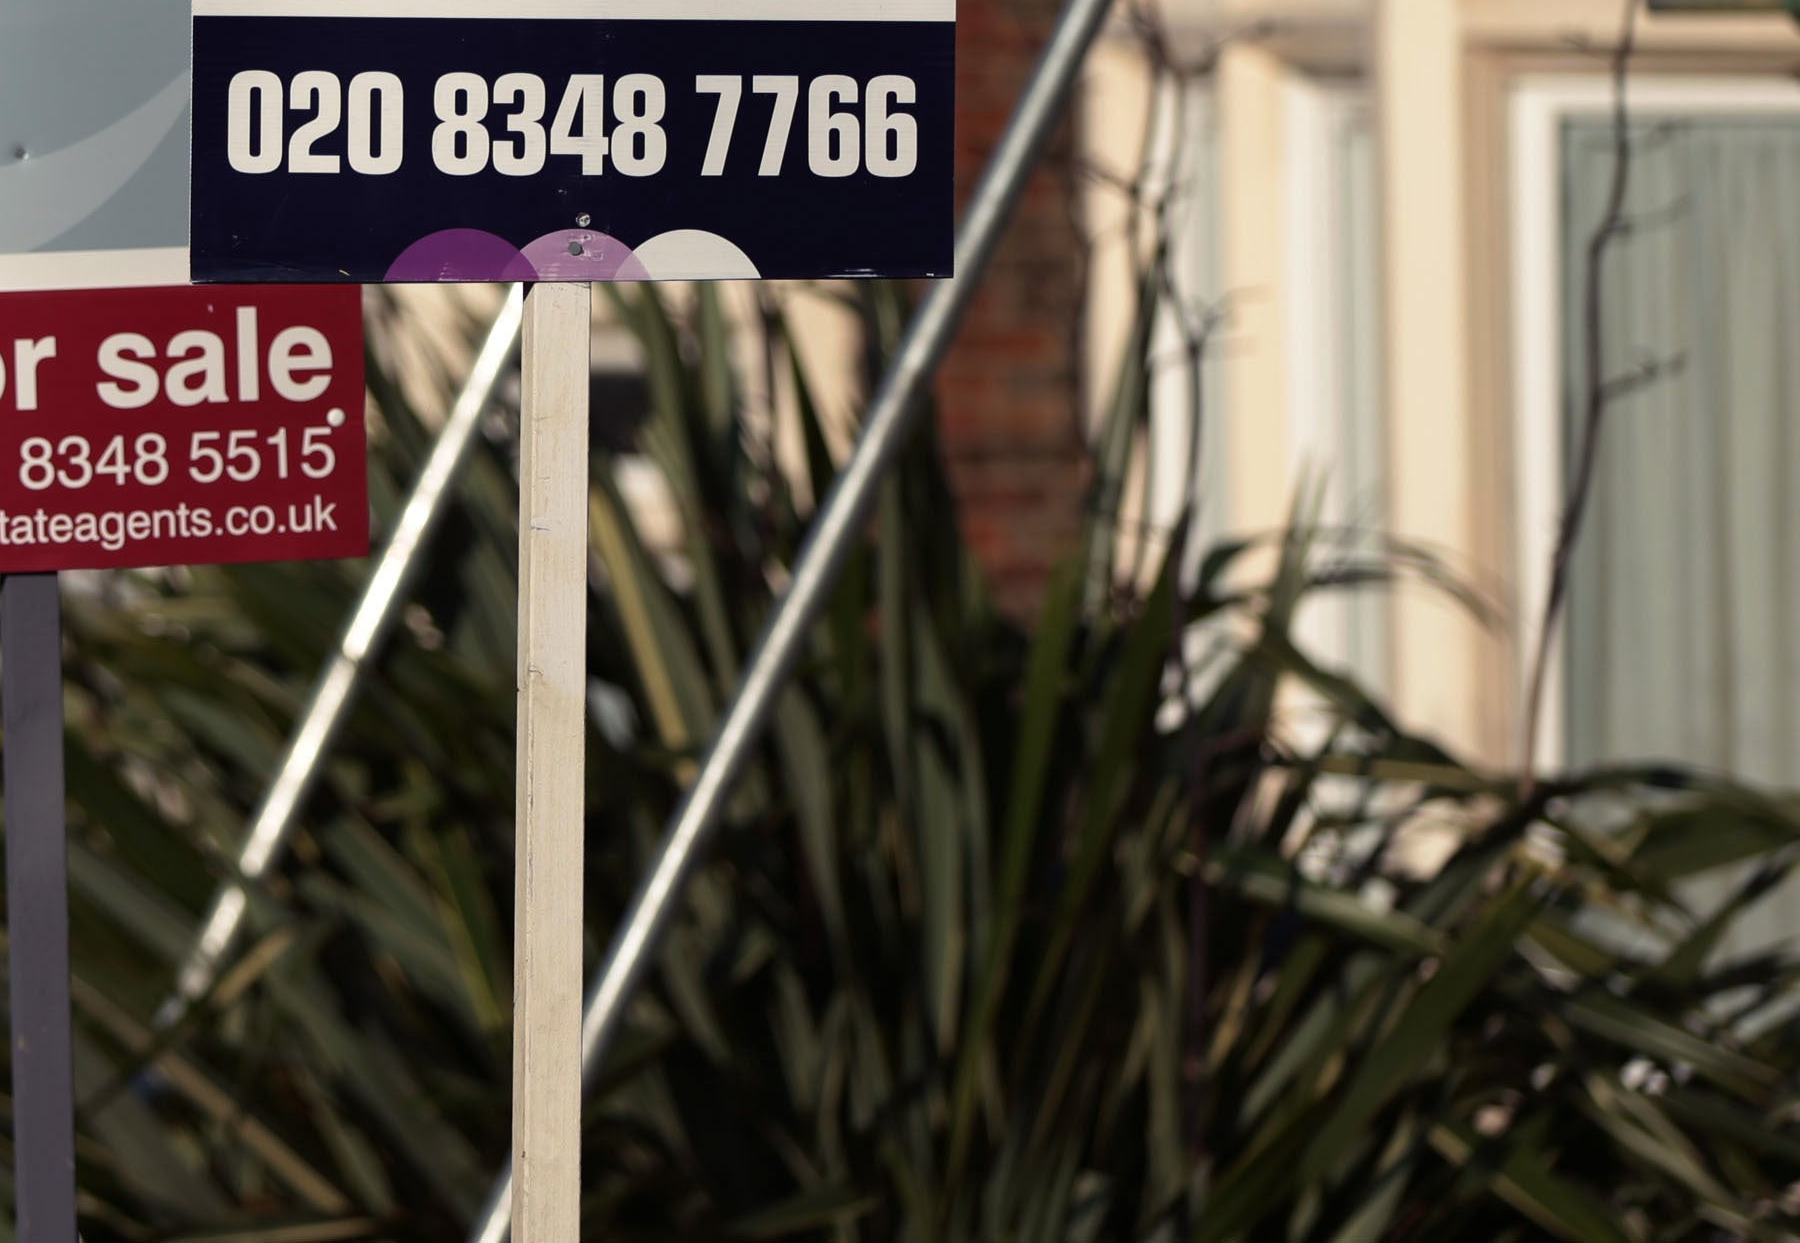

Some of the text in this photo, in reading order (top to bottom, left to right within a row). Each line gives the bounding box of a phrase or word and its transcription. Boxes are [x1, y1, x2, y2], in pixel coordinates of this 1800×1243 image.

[227, 69, 918, 178] 020 8348 7766
[96, 306, 333, 409] sale
[19, 432, 169, 490] 8348
[188, 426, 336, 483] 5515
